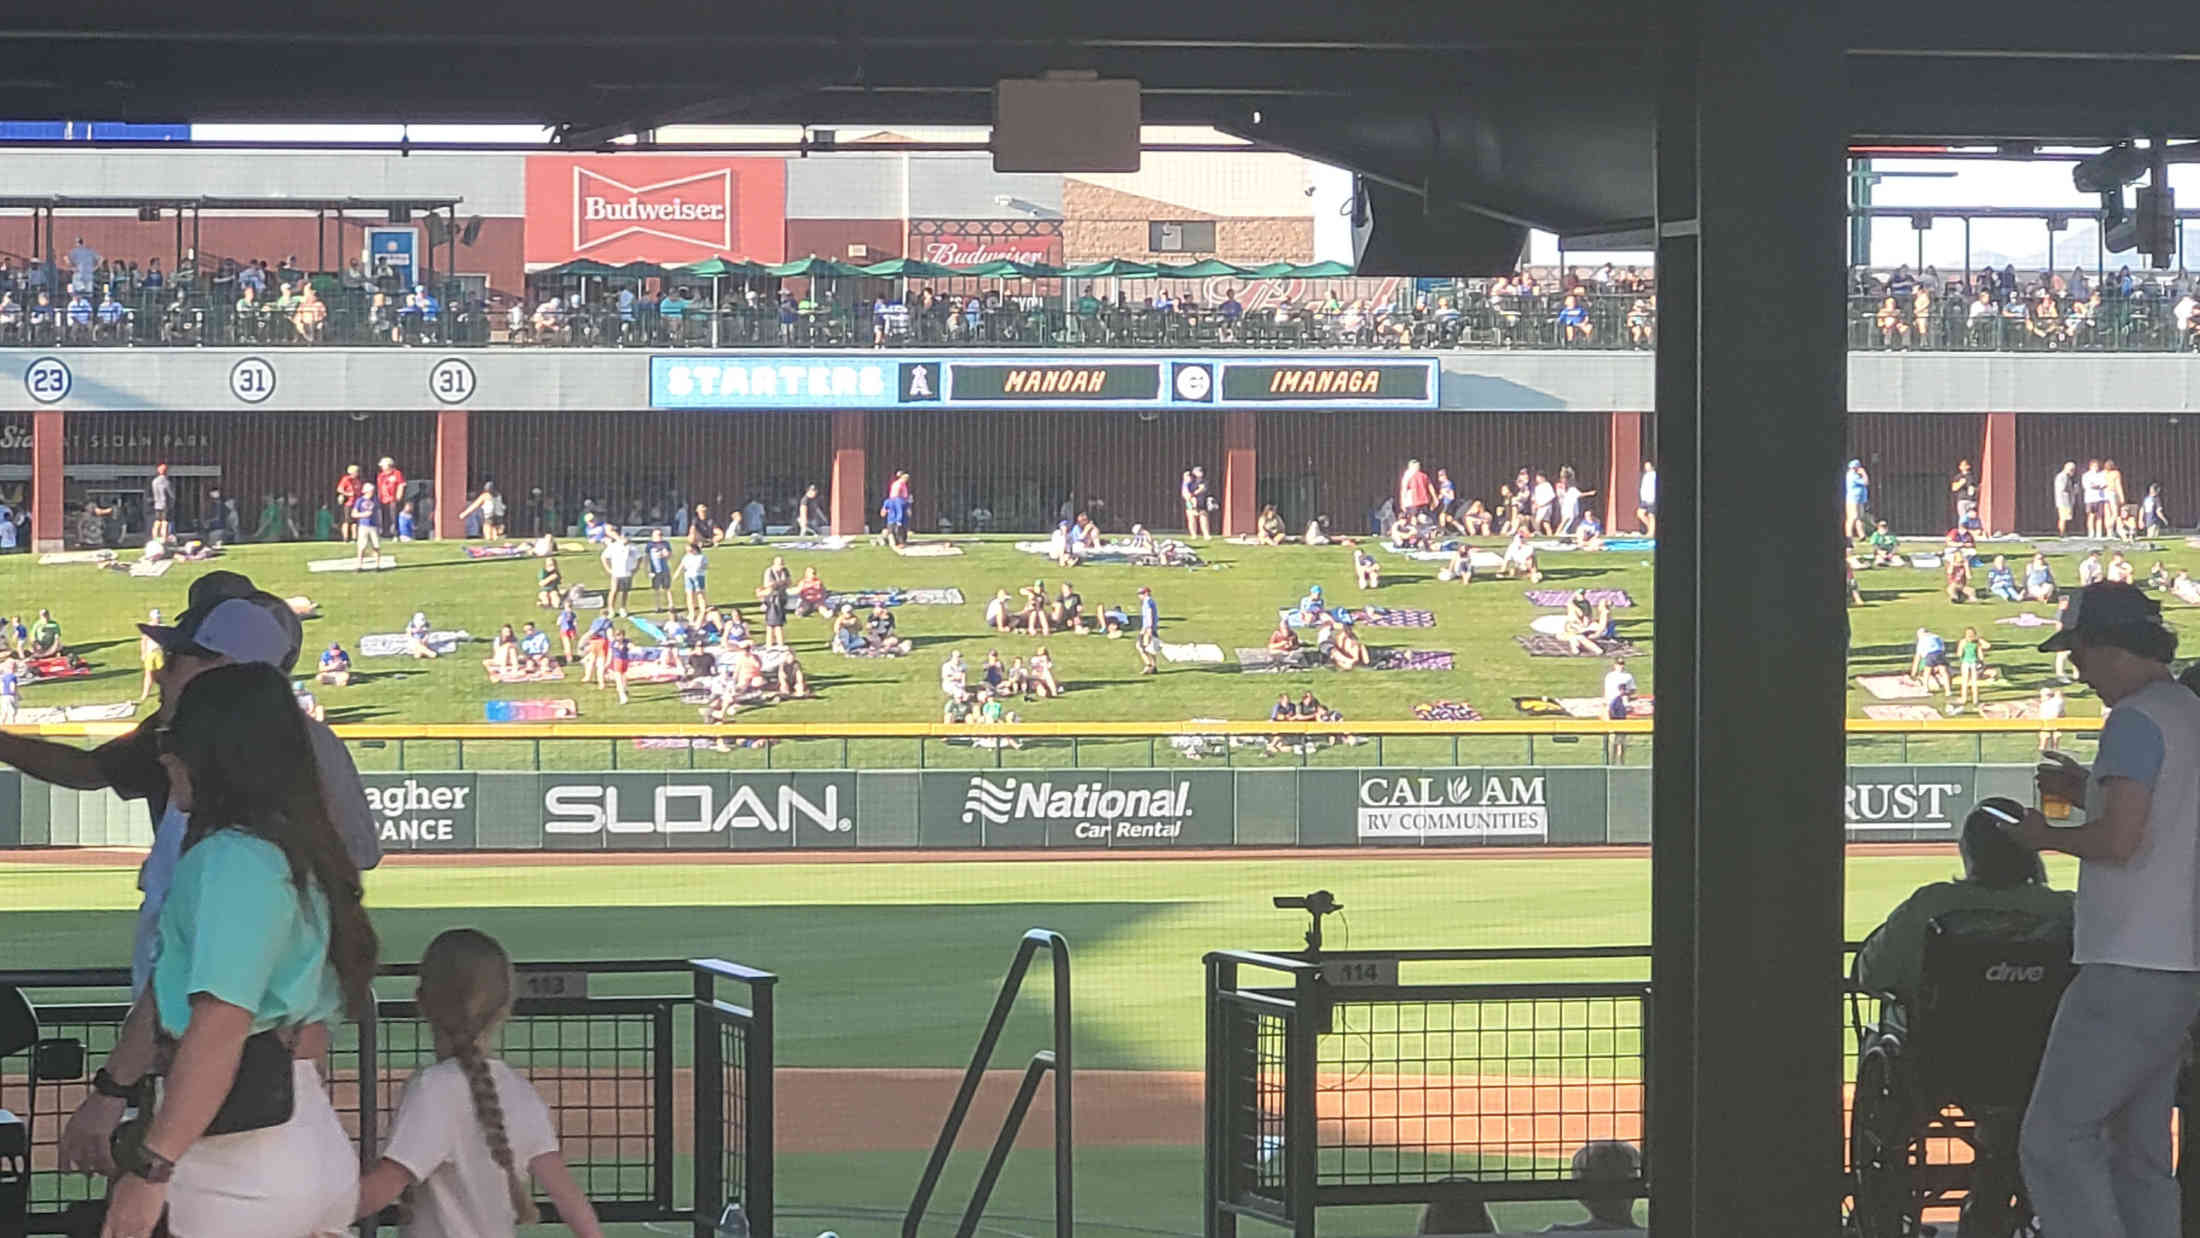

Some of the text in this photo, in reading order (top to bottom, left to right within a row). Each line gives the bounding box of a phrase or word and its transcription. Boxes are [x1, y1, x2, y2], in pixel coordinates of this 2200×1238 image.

[927, 242, 1044, 266] Budweiser
[34, 369, 63, 391] 23
[239, 369, 265, 392] 31
[439, 370, 466, 392] 31
[667, 365, 885, 396] STARTERS
[1003, 370, 1106, 392] MANOAH
[1269, 370, 1380, 393] IMANAGA
[90, 434, 151, 447] SLOAN
[163, 434, 209, 447] PARK
[363, 779, 469, 817] agher
[1360, 777, 1545, 805] CAL AM
[1845, 784, 1952, 819] RUST
[375, 819, 453, 841] ANCE
[1074, 821, 1182, 838] Car Rental
[1368, 812, 1539, 830] RV COMMUNITIES
[1342, 964, 1378, 981] 114
[1985, 961, 2044, 982] drive
[528, 976, 566, 995] 113
